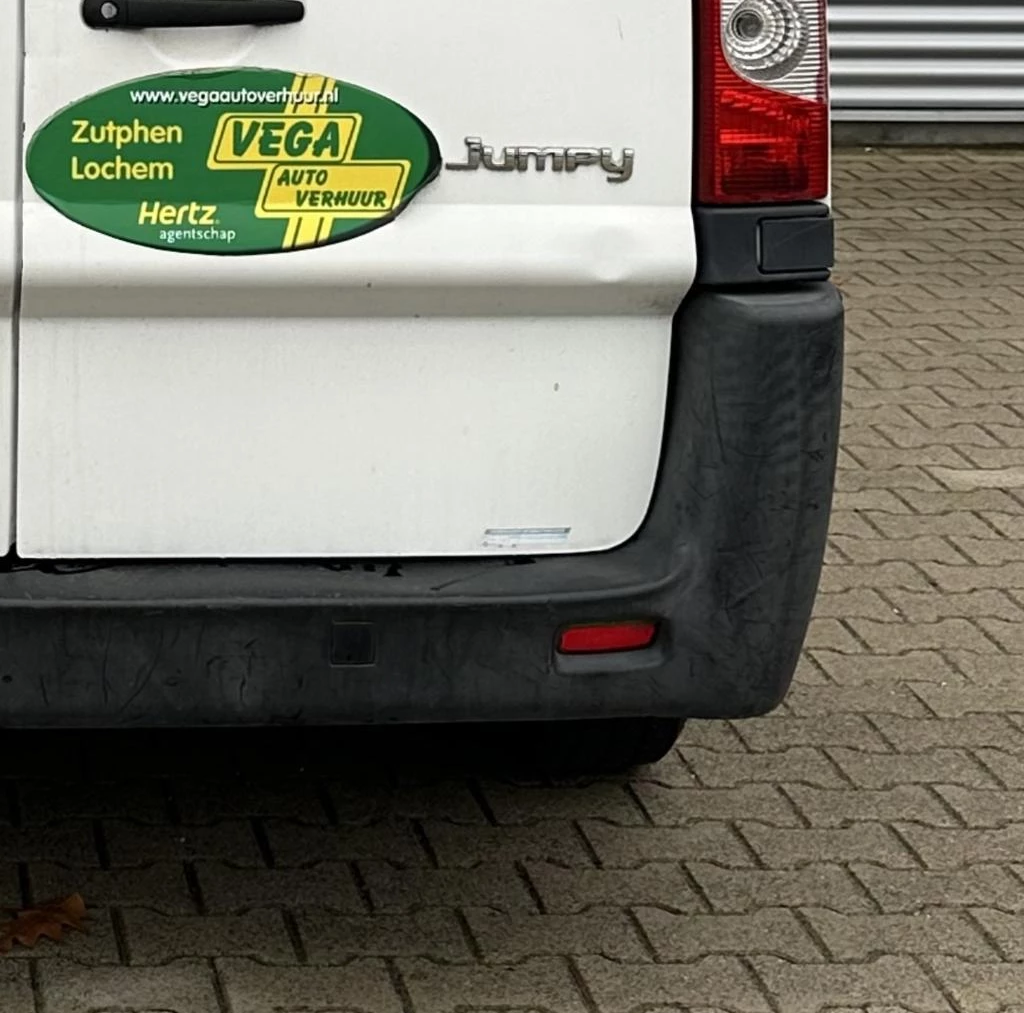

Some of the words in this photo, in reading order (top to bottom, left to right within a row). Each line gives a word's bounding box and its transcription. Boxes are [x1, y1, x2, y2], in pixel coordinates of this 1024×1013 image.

[130, 87, 339, 107] www.vegaautoverhuur.nl
[71, 119, 183, 148] Zutphen
[232, 120, 341, 158] VEGA
[71, 156, 174, 182] Lochem
[276, 169, 328, 187] AUTO
[294, 192, 387, 209] VERHUUR
[138, 201, 219, 225] Hertz
[159, 227, 236, 243] agentschap
